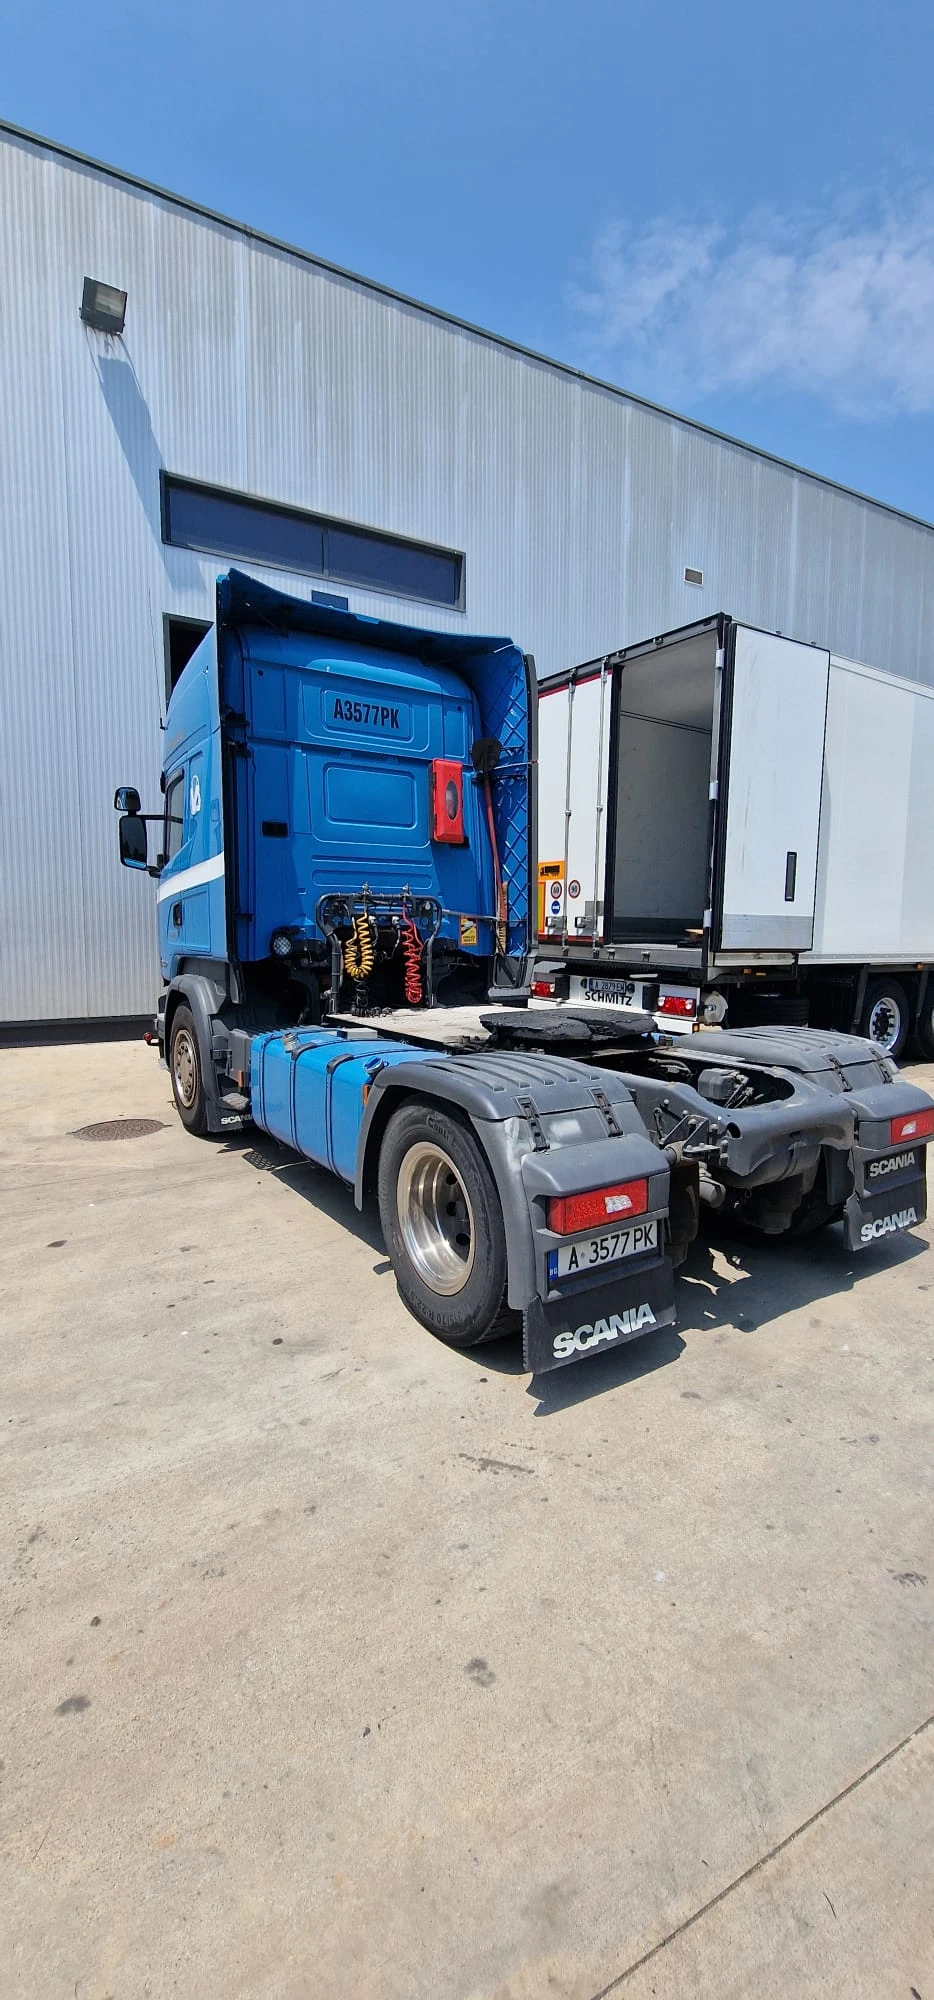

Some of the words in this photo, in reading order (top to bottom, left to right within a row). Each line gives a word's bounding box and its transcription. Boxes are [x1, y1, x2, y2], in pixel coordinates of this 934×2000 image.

[333, 698, 399, 728] A3577PK
[585, 991, 632, 1006] SCHMITZ
[869, 1152, 915, 1177] SCANIA
[860, 1207, 917, 1242] SCANIA
[568, 1246, 579, 1270] A
[589, 1231, 630, 1264] 3577
[633, 1223, 654, 1251] PK
[553, 1303, 657, 1359] SCANIA
